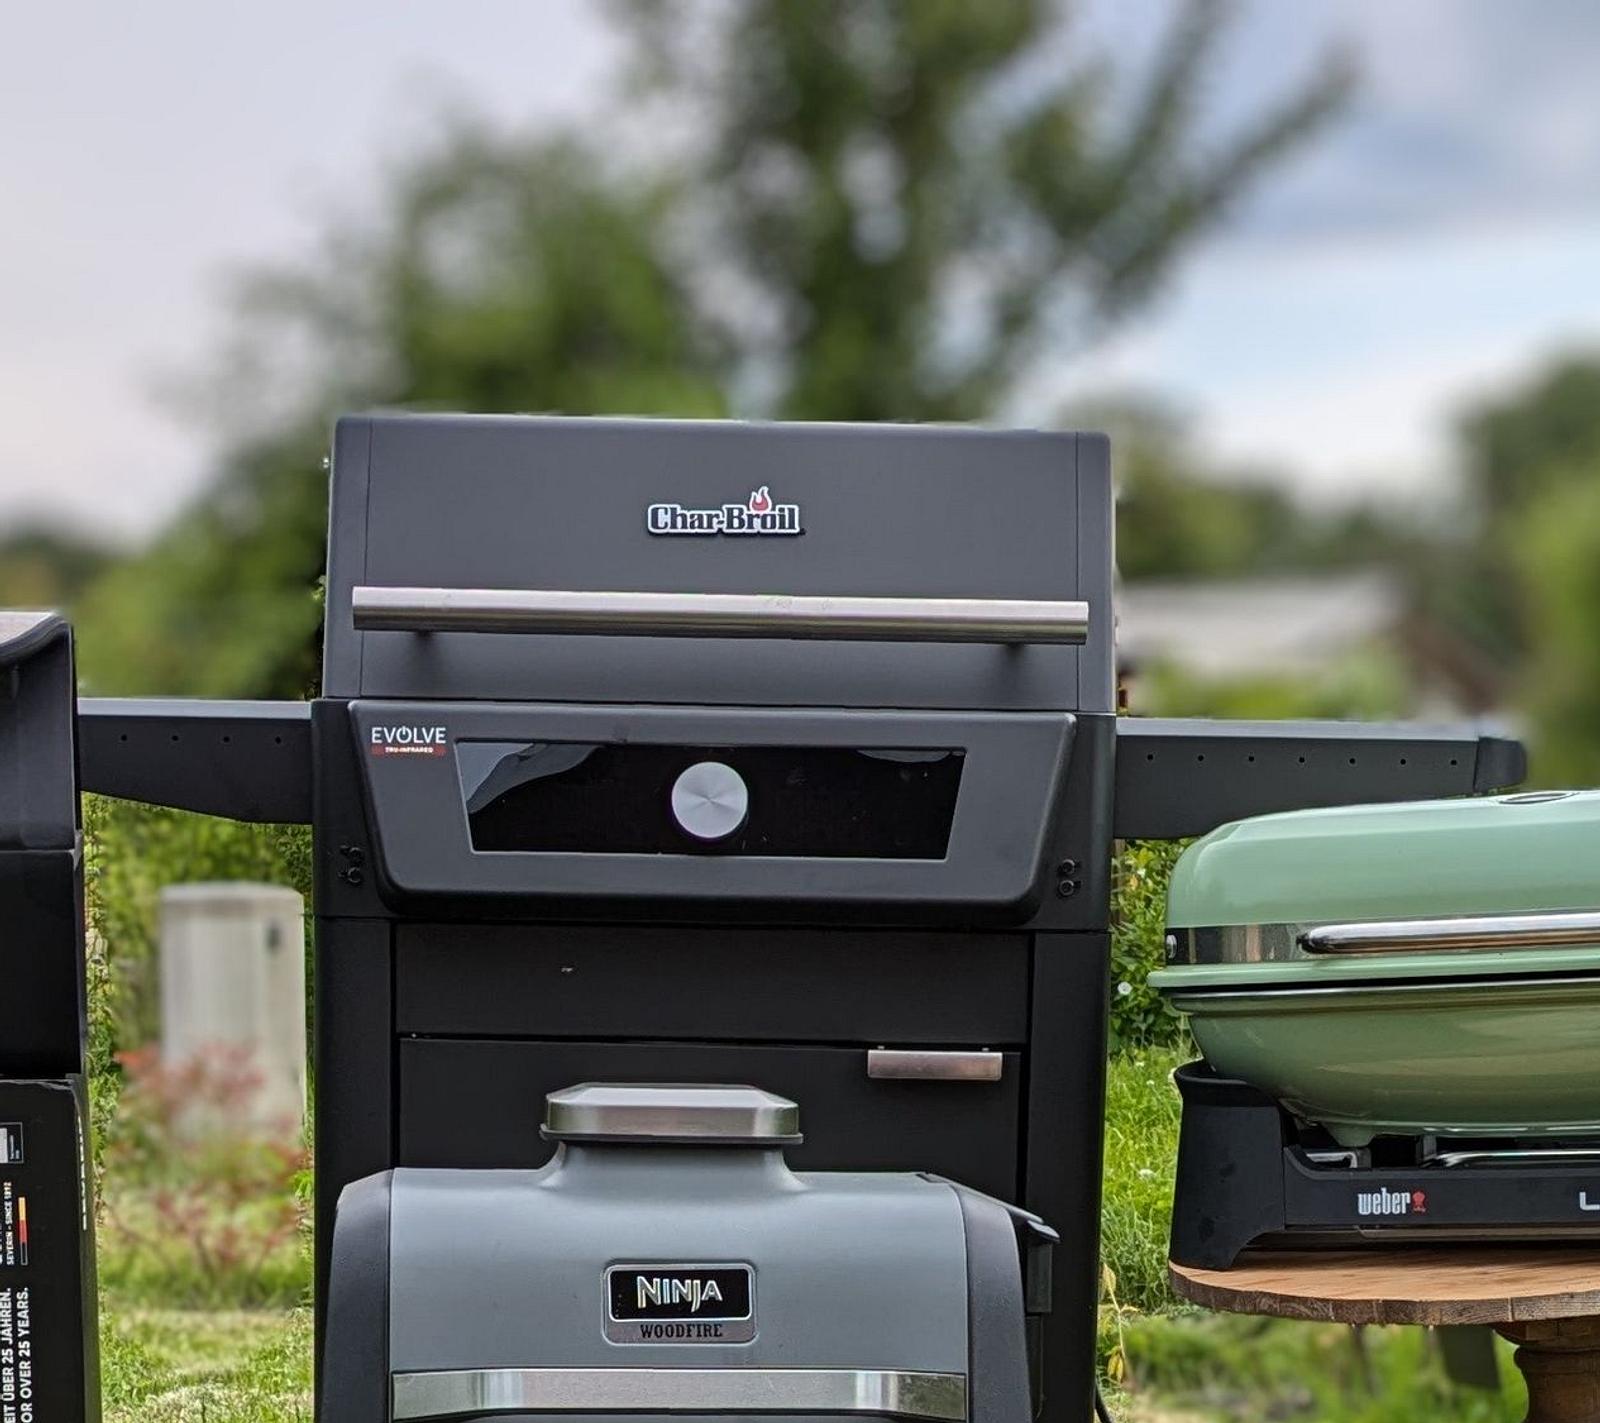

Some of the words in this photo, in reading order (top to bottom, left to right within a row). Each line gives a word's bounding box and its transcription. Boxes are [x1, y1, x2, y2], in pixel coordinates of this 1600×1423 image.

[648, 504, 800, 533] Char-Broil
[371, 726, 446, 744] EVOLVE
[4, 1201, 13, 1224] SINCE
[1357, 1187, 1411, 1215] weber
[636, 1275, 724, 1312] NINJA
[0, 1287, 13, 1345] JAHREN.
[16, 1287, 30, 1337] YEARS.
[640, 1324, 723, 1338] WOODFIRE
[2, 1348, 14, 1364] 25
[18, 1340, 31, 1357] 25
[0, 1367, 15, 1401] ÜBER
[19, 1360, 32, 1399] OVER
